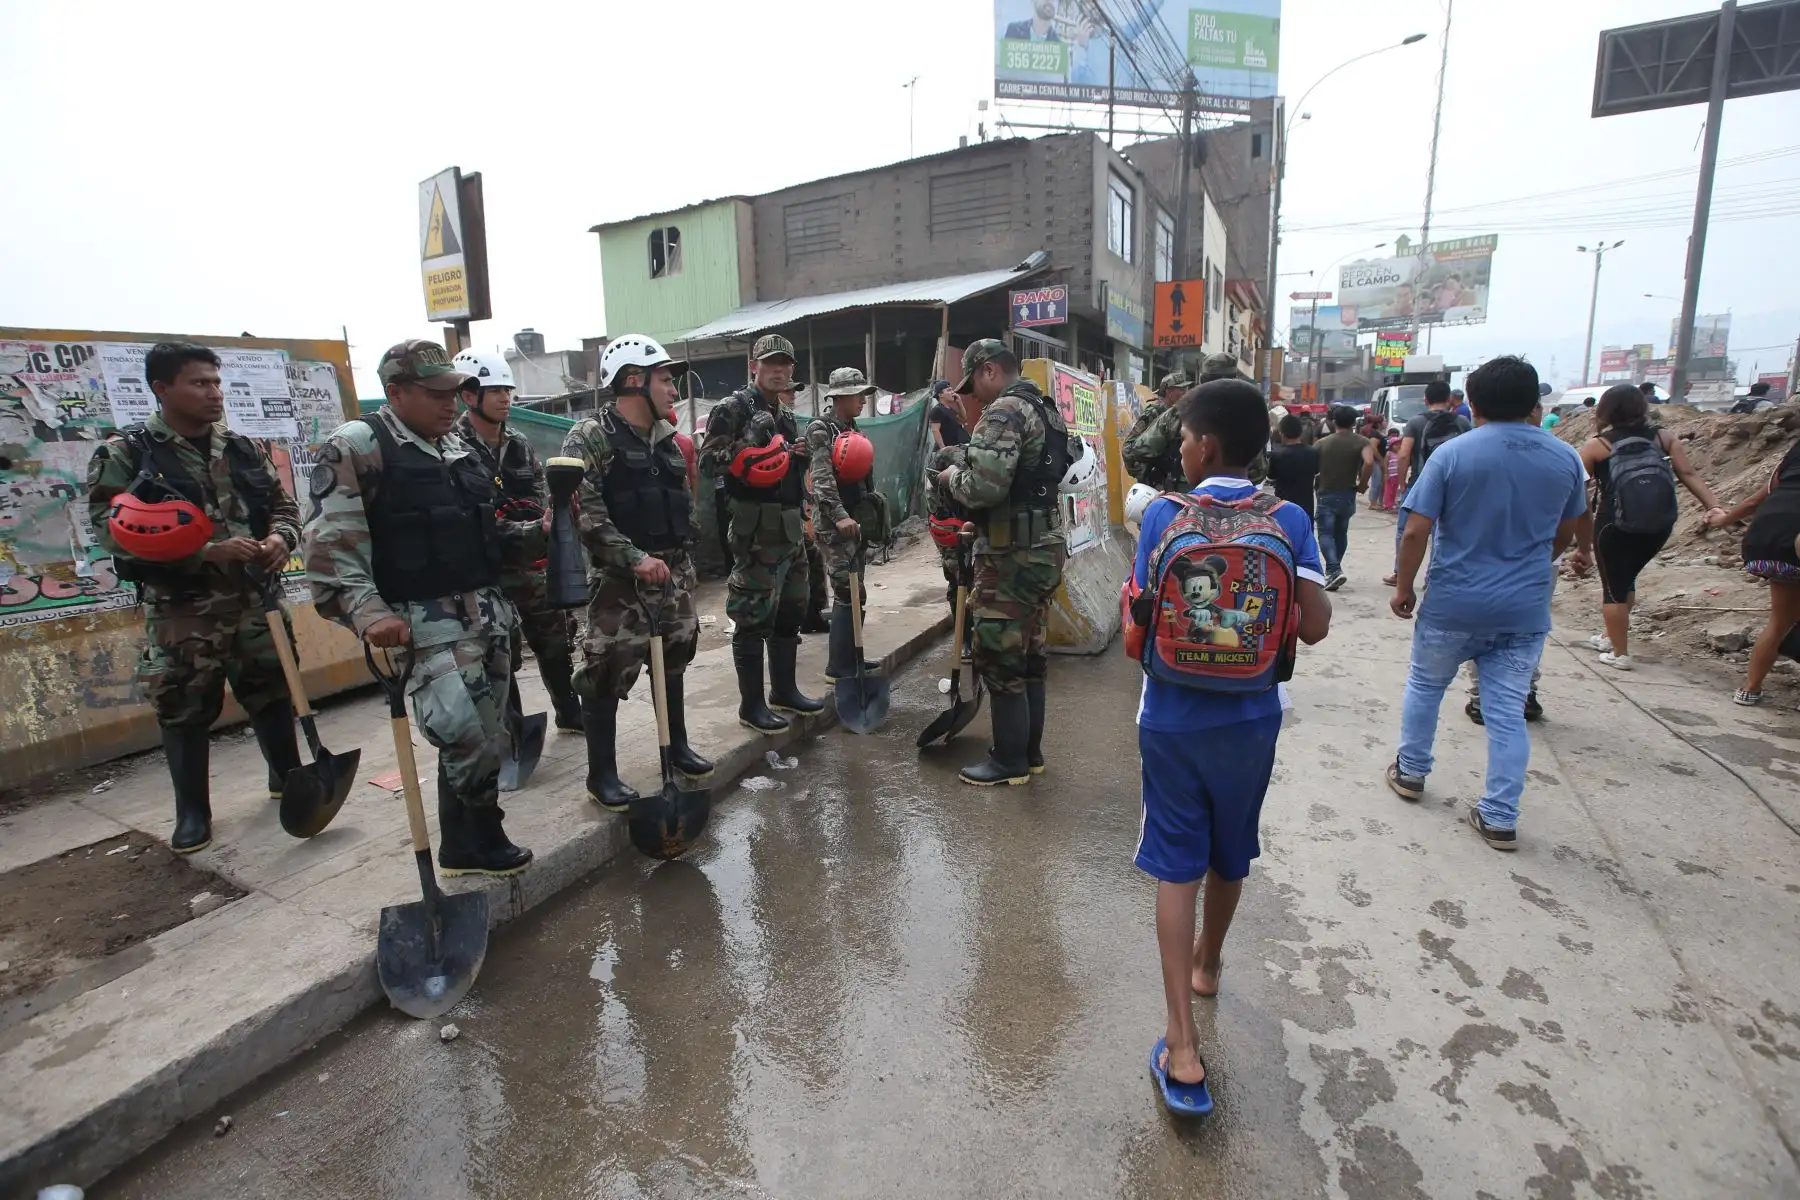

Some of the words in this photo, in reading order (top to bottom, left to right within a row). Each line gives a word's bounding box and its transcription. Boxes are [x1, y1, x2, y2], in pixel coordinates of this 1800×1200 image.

[1194, 14, 1216, 29] SOLO
[1194, 26, 1224, 43] FALTAS
[1032, 53, 1061, 71] 2227
[1039, 85, 1068, 97] CENTRAL
[1069, 87, 1080, 97] KM
[428, 269, 462, 286] PELIGRO
[1341, 279, 1355, 289] EL
[1356, 274, 1400, 287] CAMPO
[1013, 288, 1065, 306] BAÑO
[1158, 333, 1196, 346] PEATON
[1243, 618, 1272, 635] GO!
[1179, 652, 1209, 662] TEAM
[1215, 653, 1254, 663] MICKEY!
